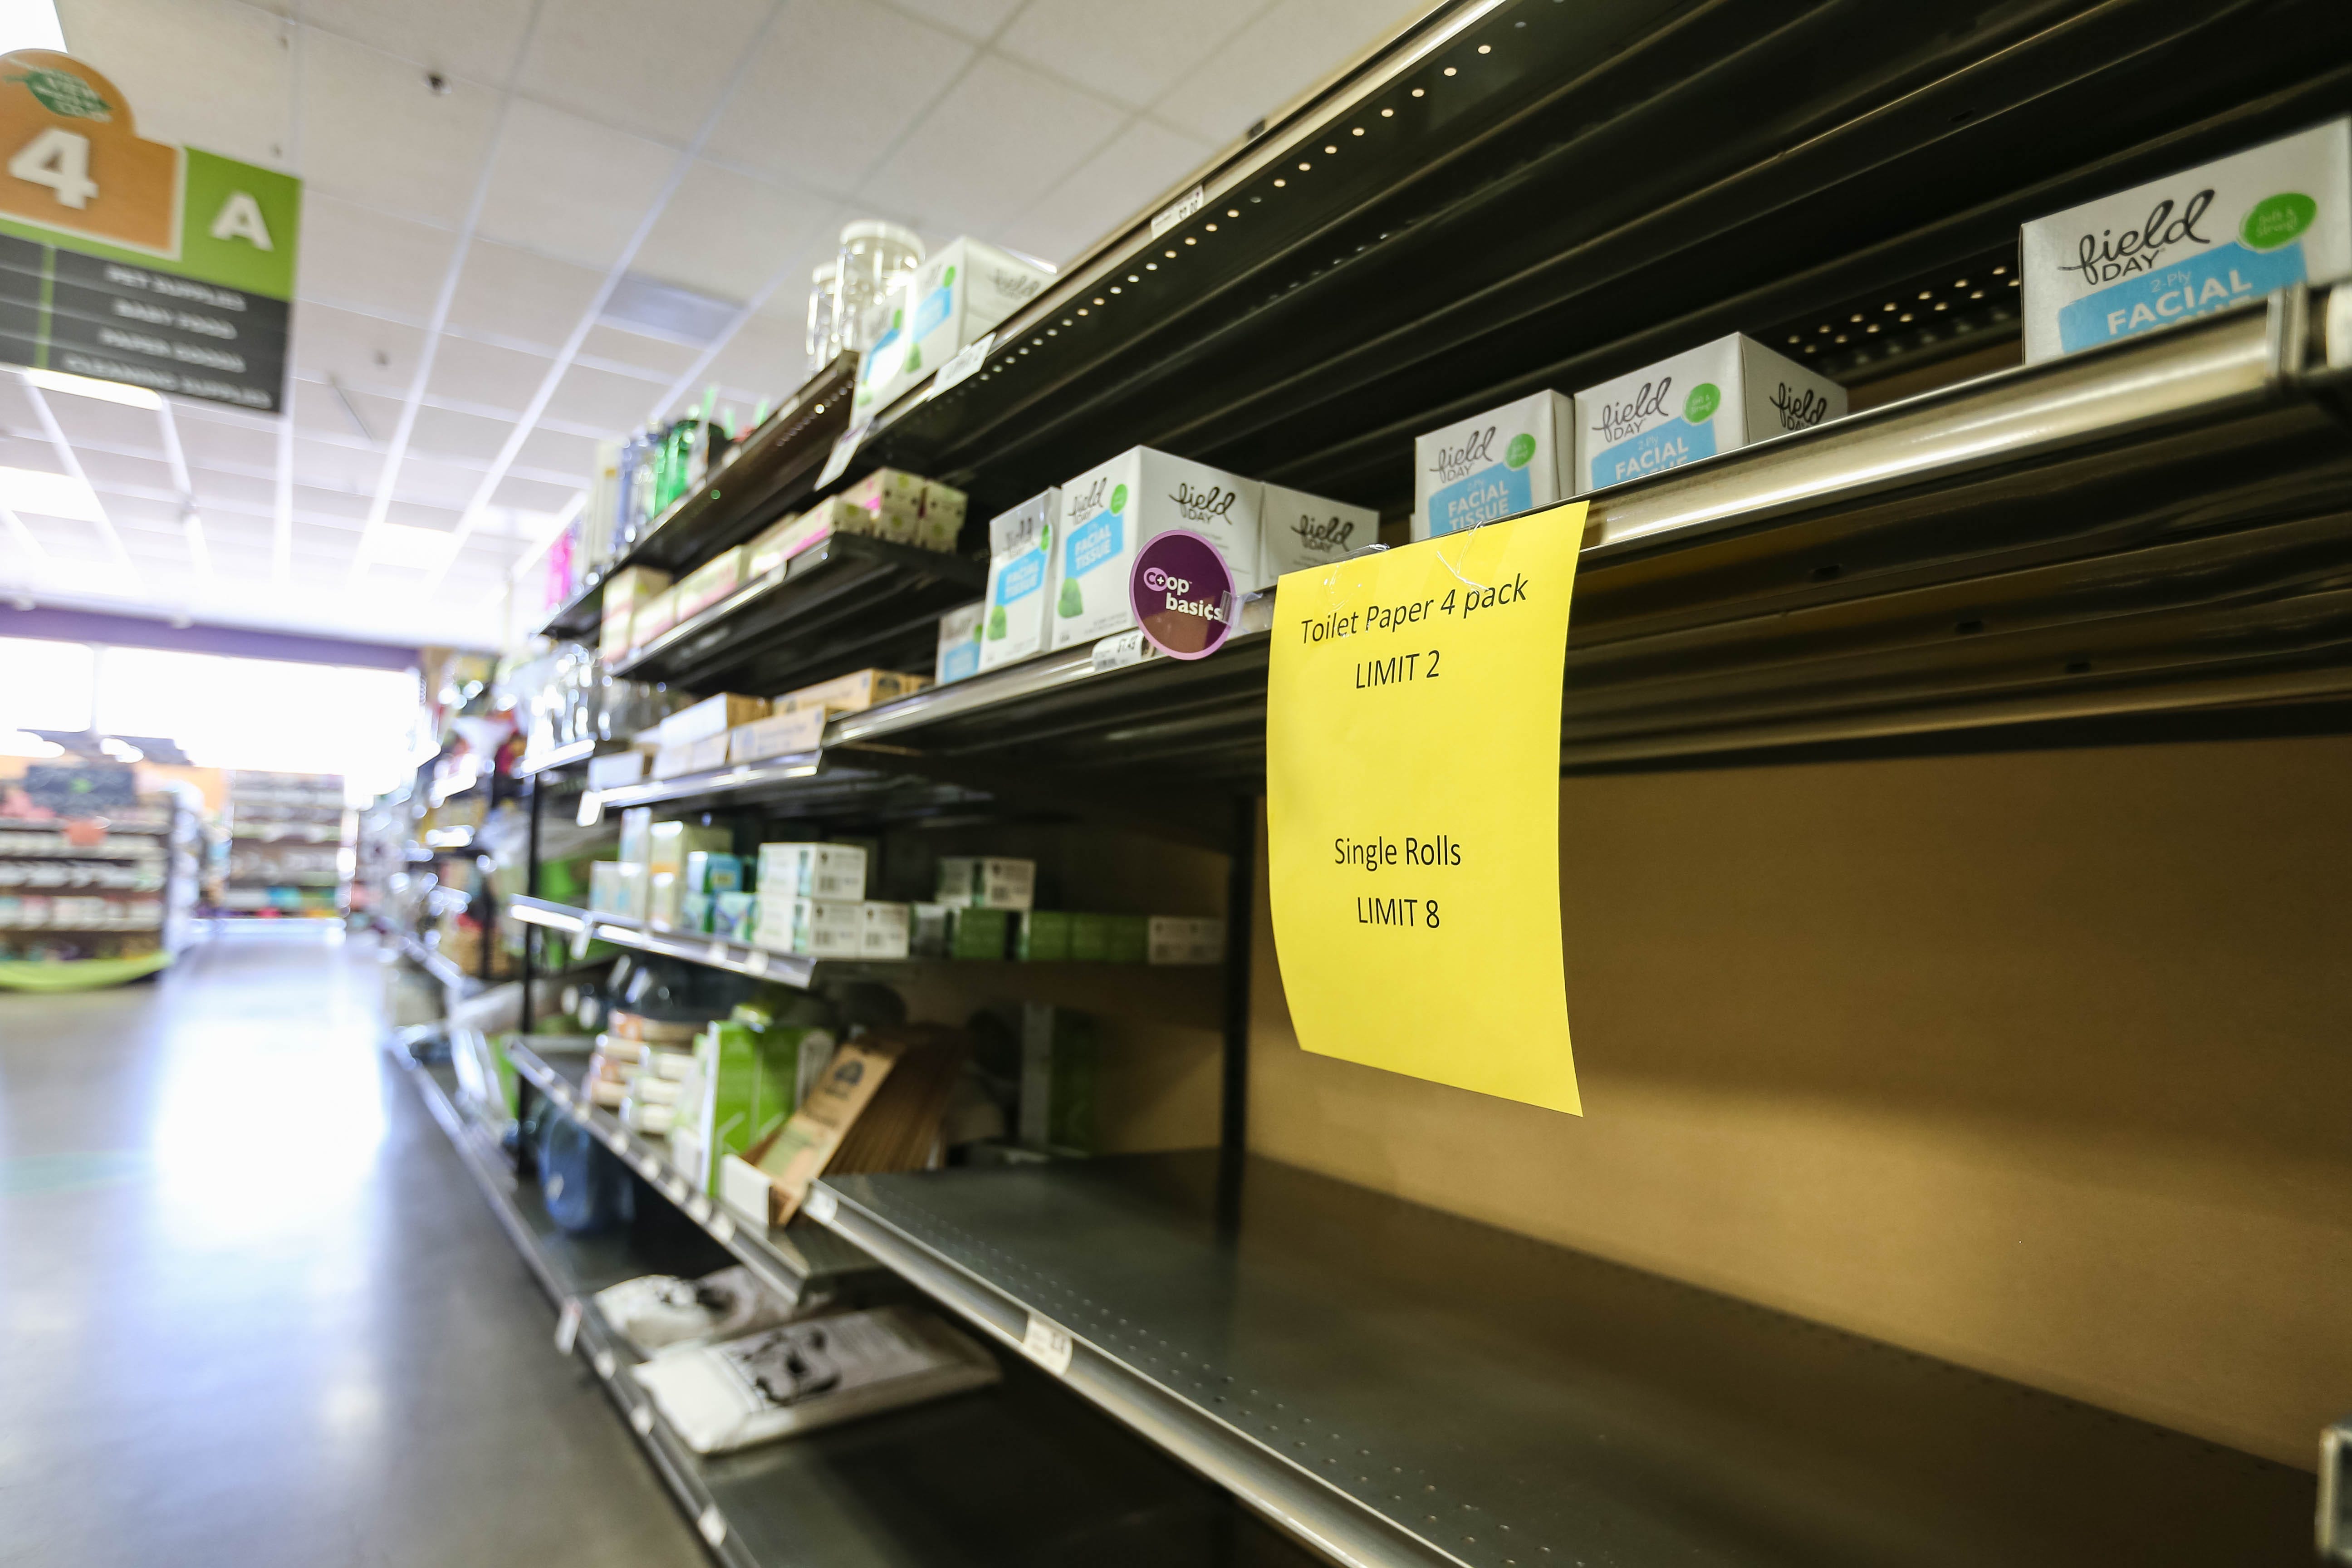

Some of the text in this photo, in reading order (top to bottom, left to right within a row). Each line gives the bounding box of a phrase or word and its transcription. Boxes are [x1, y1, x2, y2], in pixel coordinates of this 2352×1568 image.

[8, 126, 99, 211] 4
[211, 191, 274, 252] A
[2058, 189, 2215, 285] field
[2103, 250, 2159, 282] DAY
[2107, 270, 2251, 335] FACIAL
[1592, 377, 1671, 442] field
[1769, 382, 1827, 428] field
[1614, 419, 1645, 440] DAY
[1430, 426, 1495, 483] field
[1447, 462, 1473, 481] DAY
[1616, 437, 1689, 480] FACIAL
[1169, 483, 1235, 525] field
[1187, 509, 1213, 524] DAY
[1448, 480, 1509, 518] FACIAL
[1290, 514, 1354, 552] field
[1301, 573, 1529, 644] Toilet Paper 4 pack
[1356, 650, 1440, 689] LIMIT 2
[1335, 834, 1461, 872] Single Rolls
[1357, 897, 1440, 929] LIMIT 8
